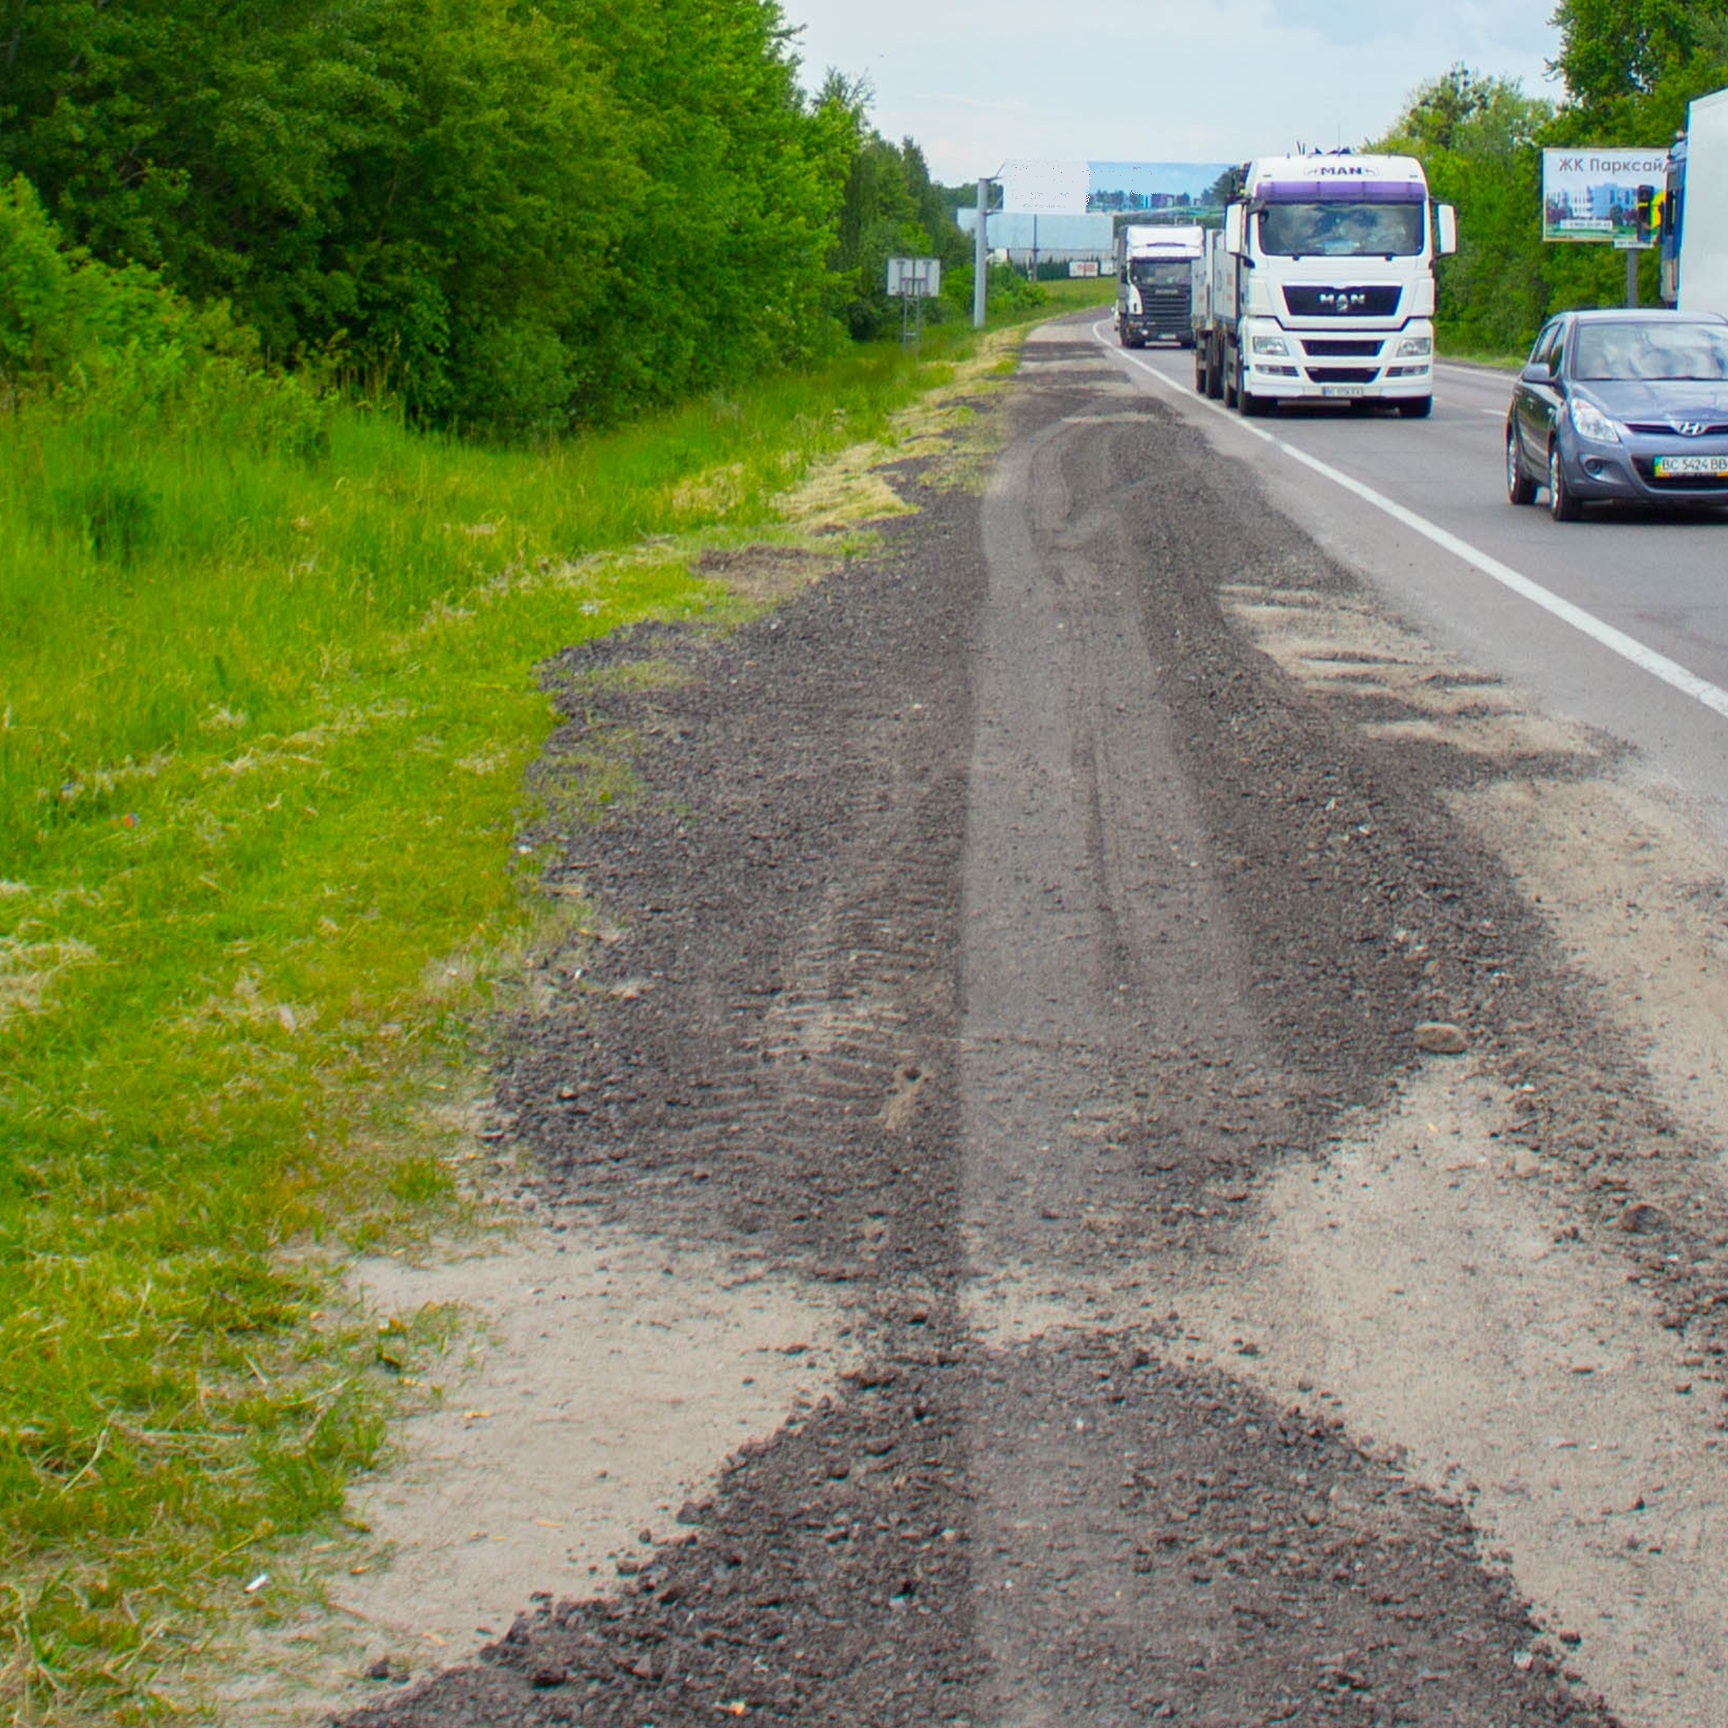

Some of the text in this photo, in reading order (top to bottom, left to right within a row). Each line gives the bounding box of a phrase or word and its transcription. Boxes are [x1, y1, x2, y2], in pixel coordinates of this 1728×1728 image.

[1320, 166, 1362, 175] MAN
[1559, 157, 1584, 172] ЖК
[1319, 293, 1365, 304] MAN
[1662, 458, 1678, 471] BC
